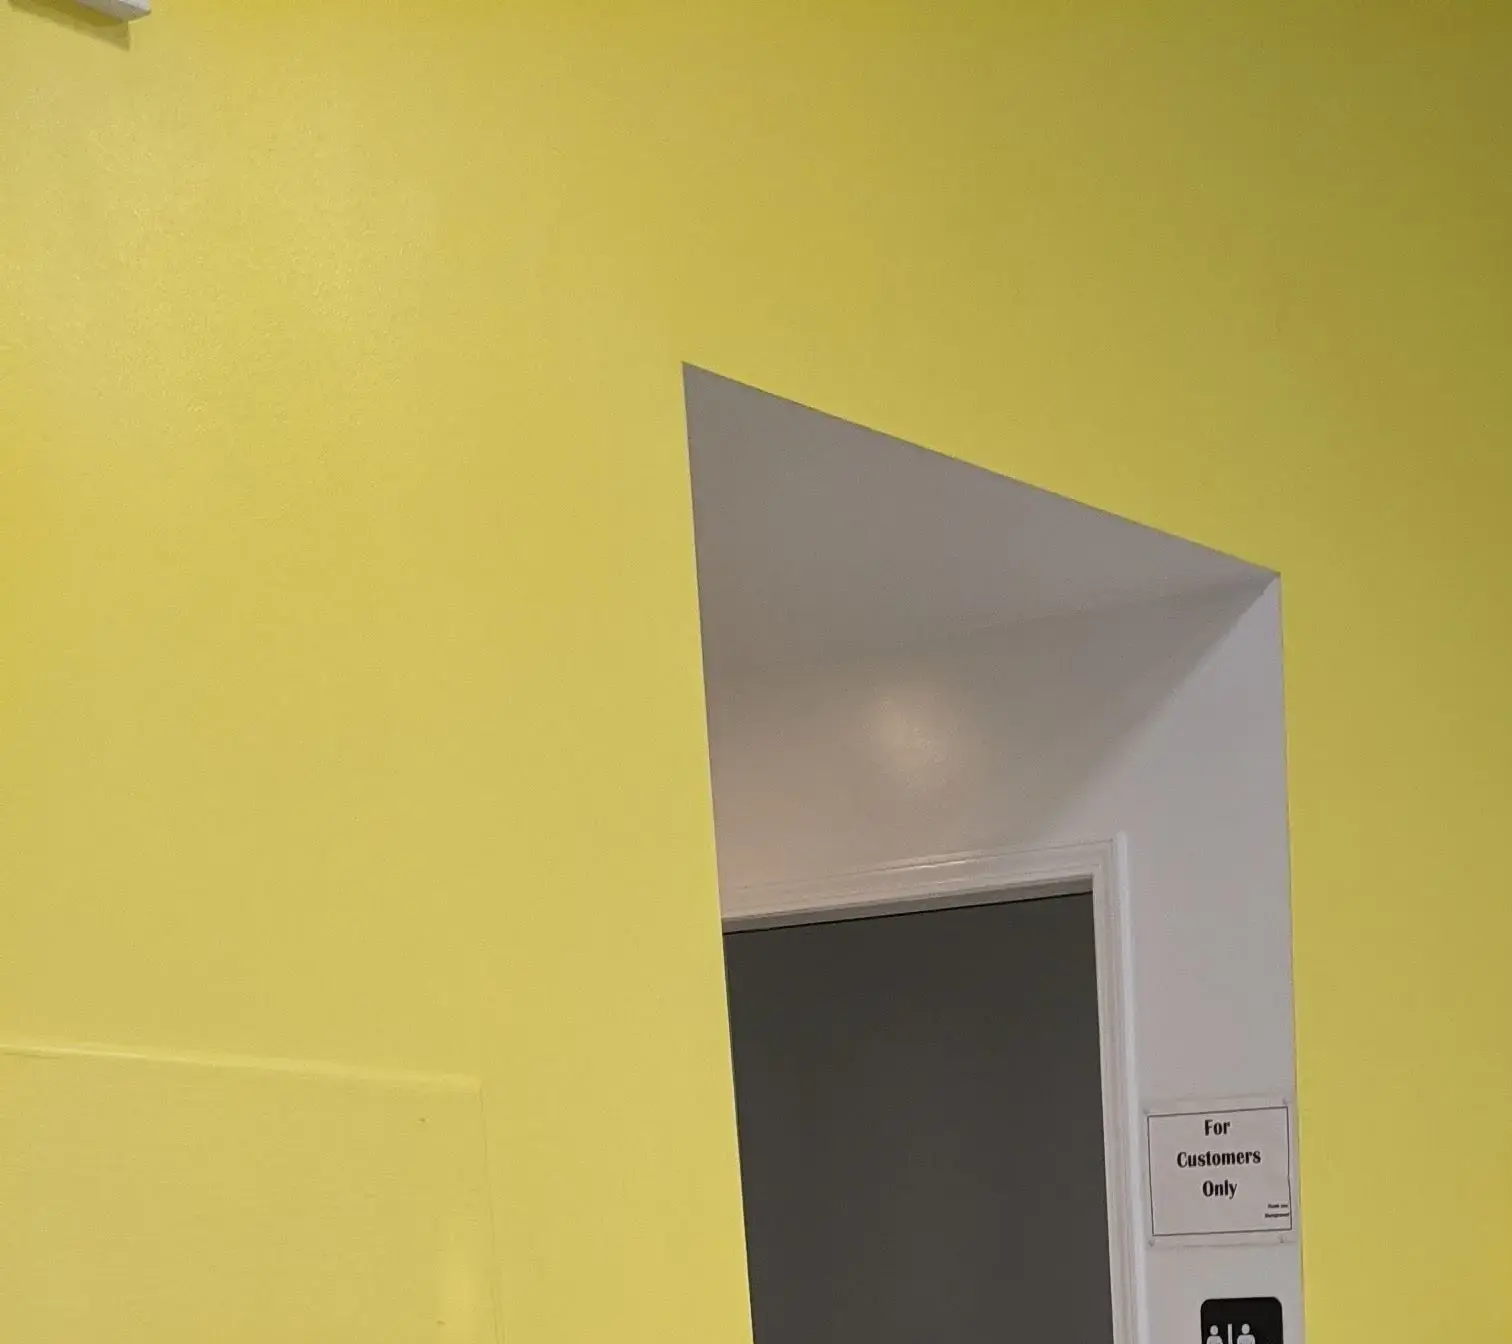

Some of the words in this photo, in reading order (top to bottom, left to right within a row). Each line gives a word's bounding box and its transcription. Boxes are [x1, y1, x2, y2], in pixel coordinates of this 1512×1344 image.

[1204, 1119, 1231, 1136] For
[1176, 1150, 1262, 1168] Customers
[1202, 1179, 1238, 1200] Only
